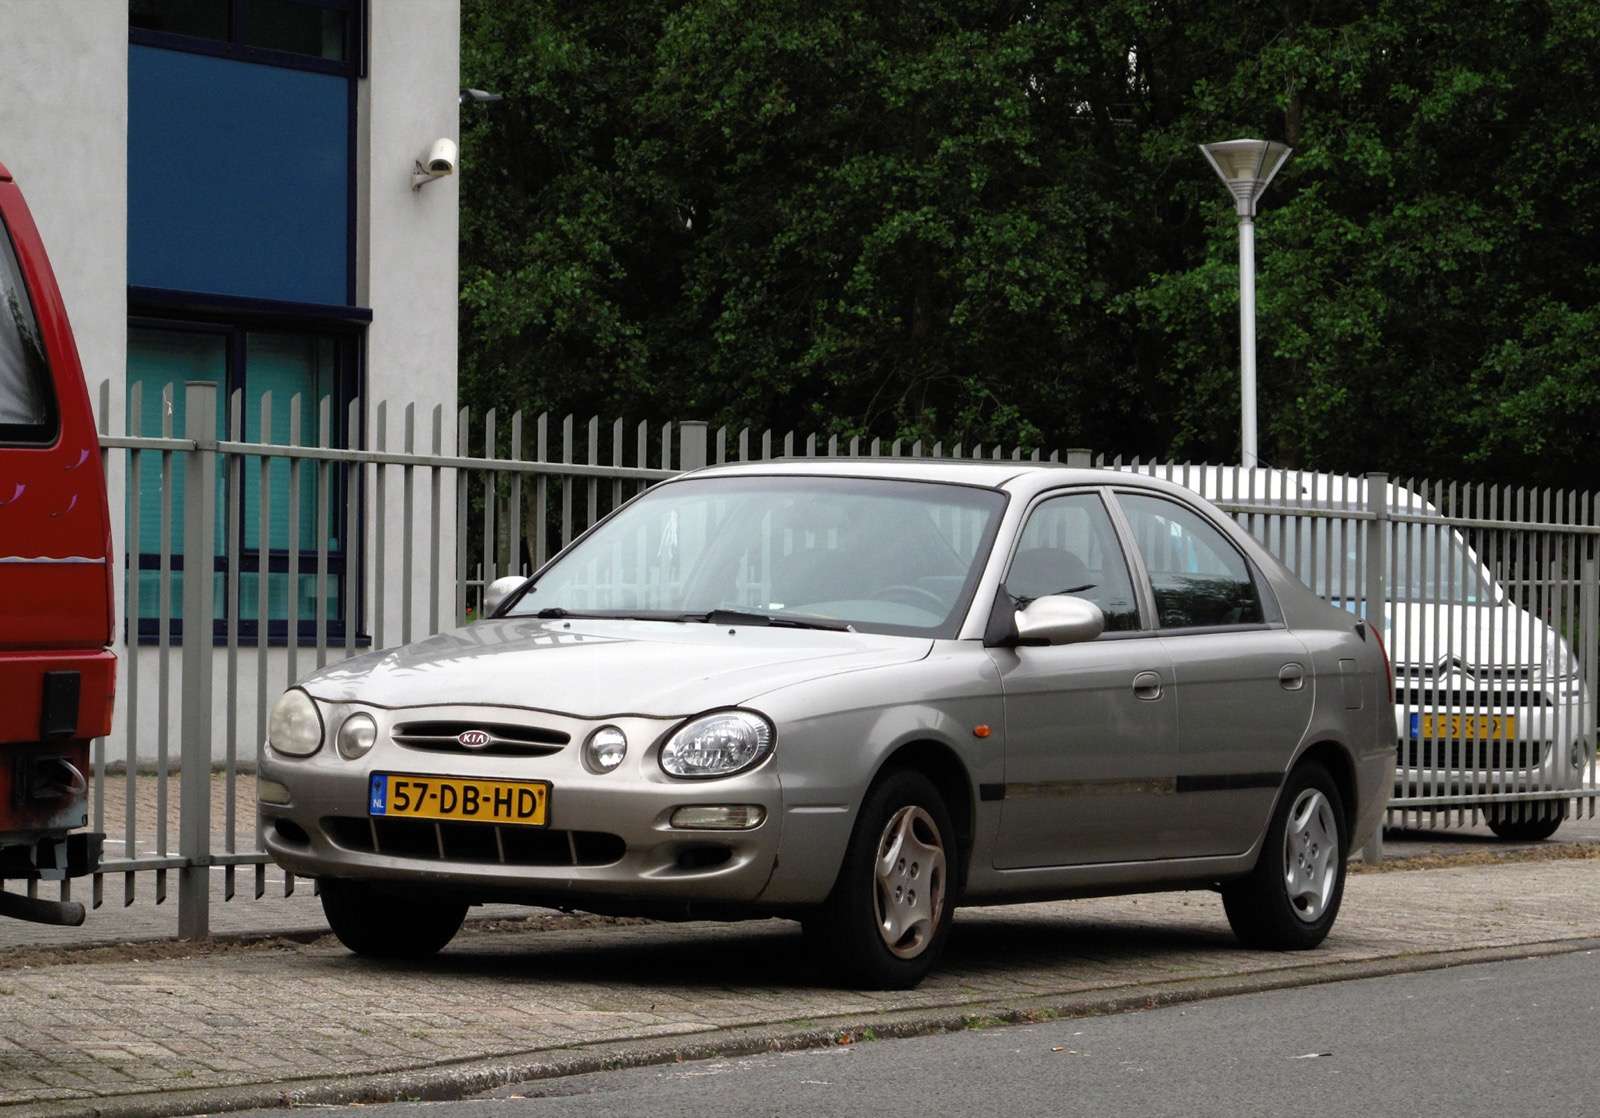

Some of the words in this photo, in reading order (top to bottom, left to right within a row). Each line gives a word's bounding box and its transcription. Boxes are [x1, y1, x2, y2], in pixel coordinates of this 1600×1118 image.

[463, 733, 484, 743] KIA
[372, 799, 384, 808] NL
[393, 781, 537, 818] 57-DB-HD
